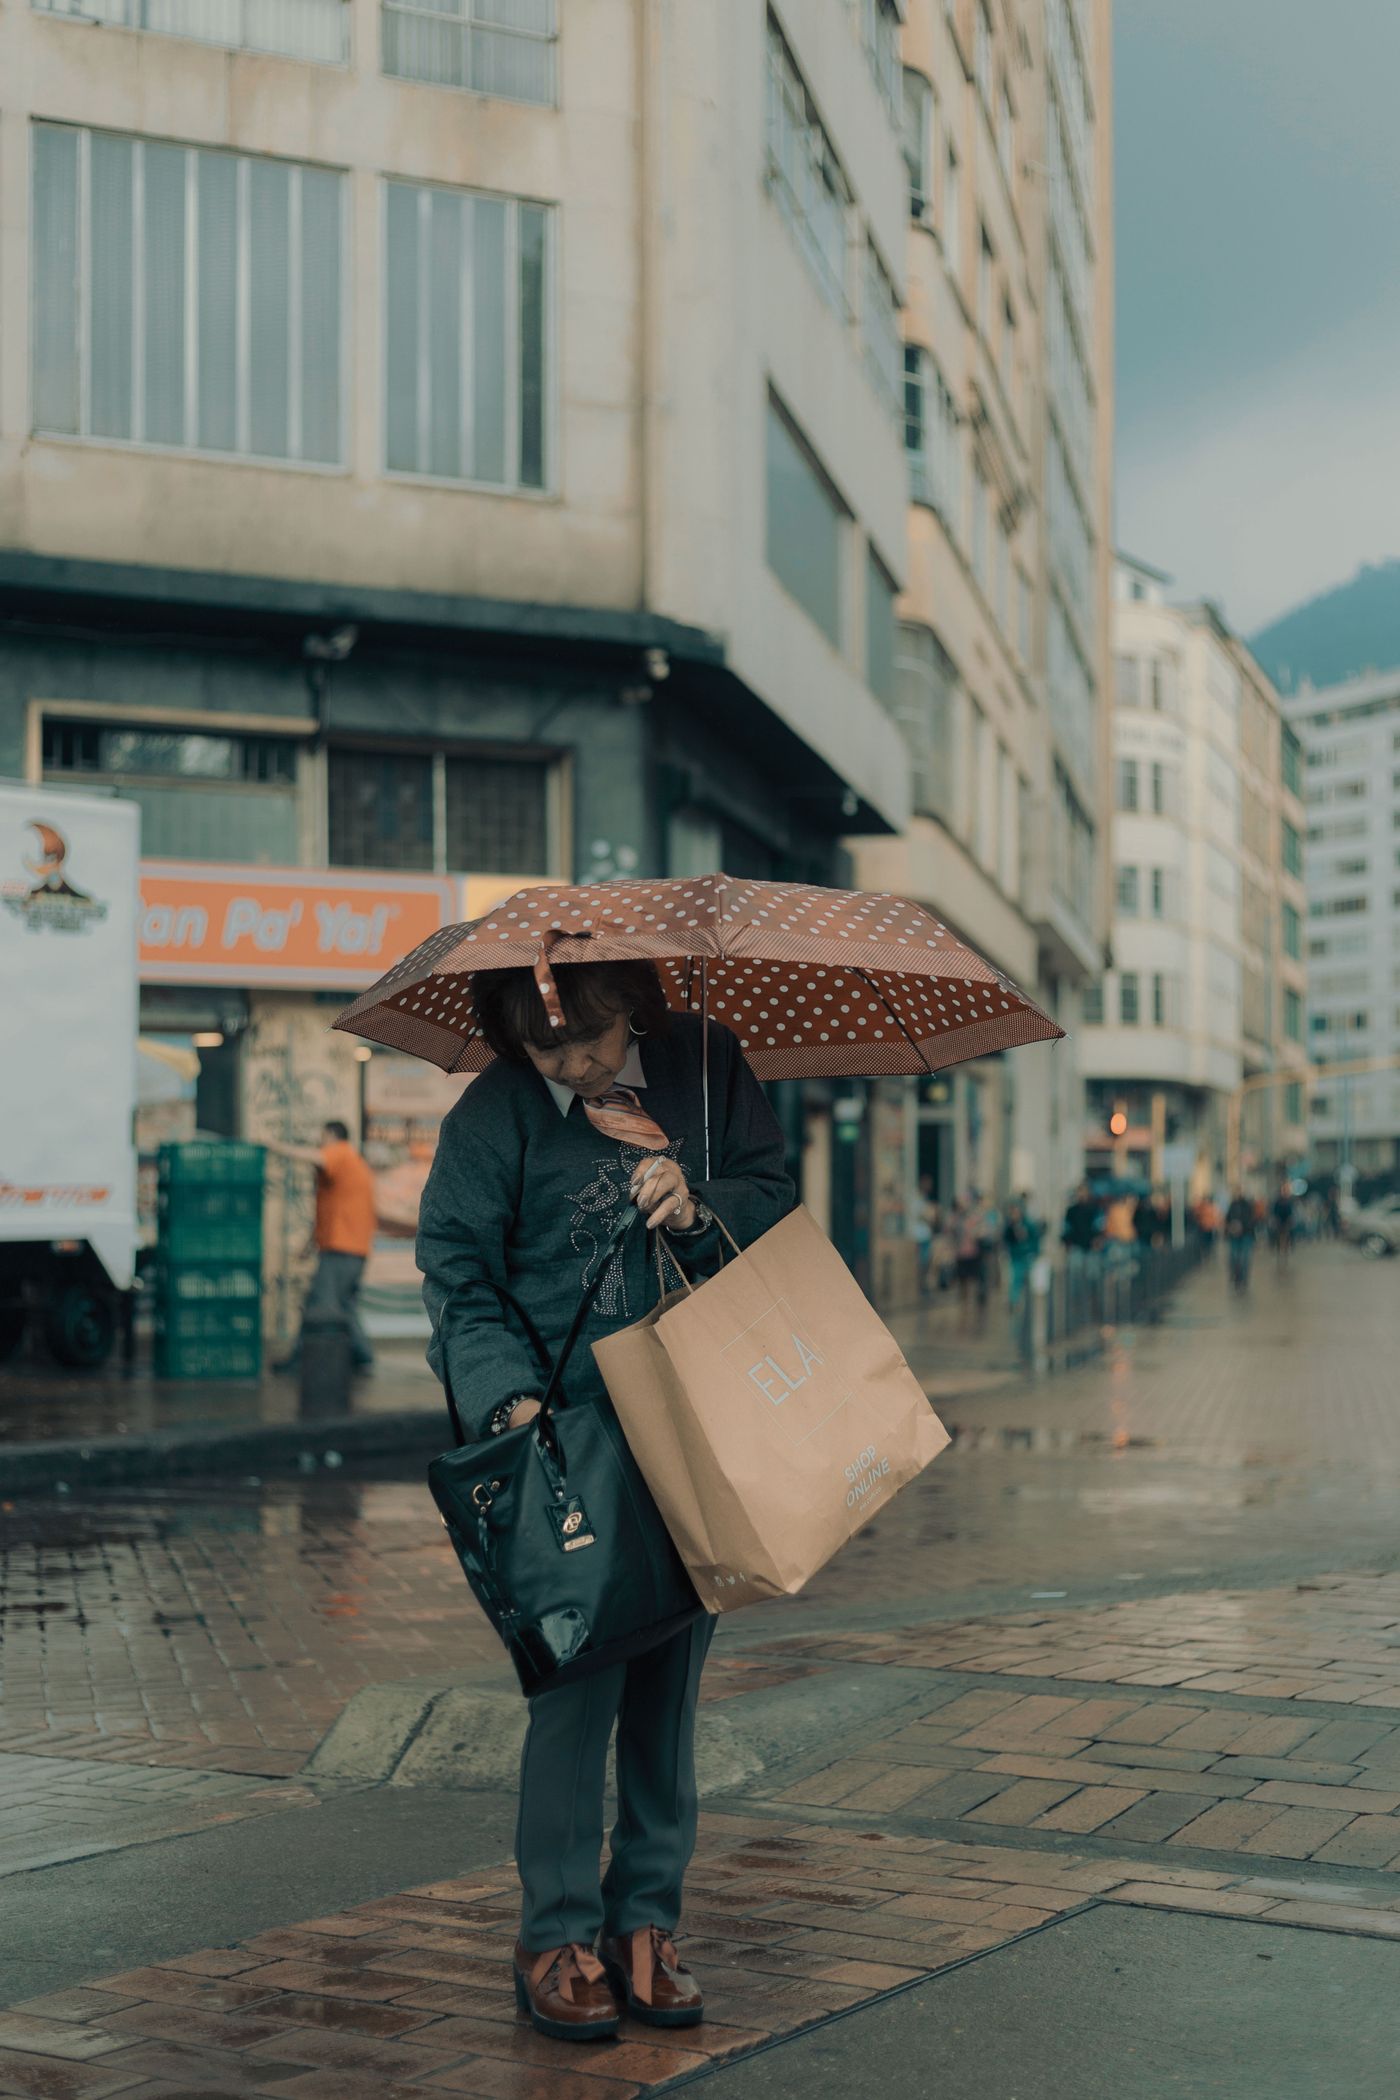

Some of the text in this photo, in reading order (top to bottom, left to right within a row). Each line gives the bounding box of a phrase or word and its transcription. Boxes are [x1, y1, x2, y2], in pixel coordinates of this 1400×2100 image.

[139, 897, 208, 948] an
[221, 898, 304, 953] Pa'
[315, 901, 389, 955] Ya!
[747, 1333, 824, 1405] ELA
[844, 1445, 875, 1483] SHOP
[846, 1456, 890, 1508] ONLINE
